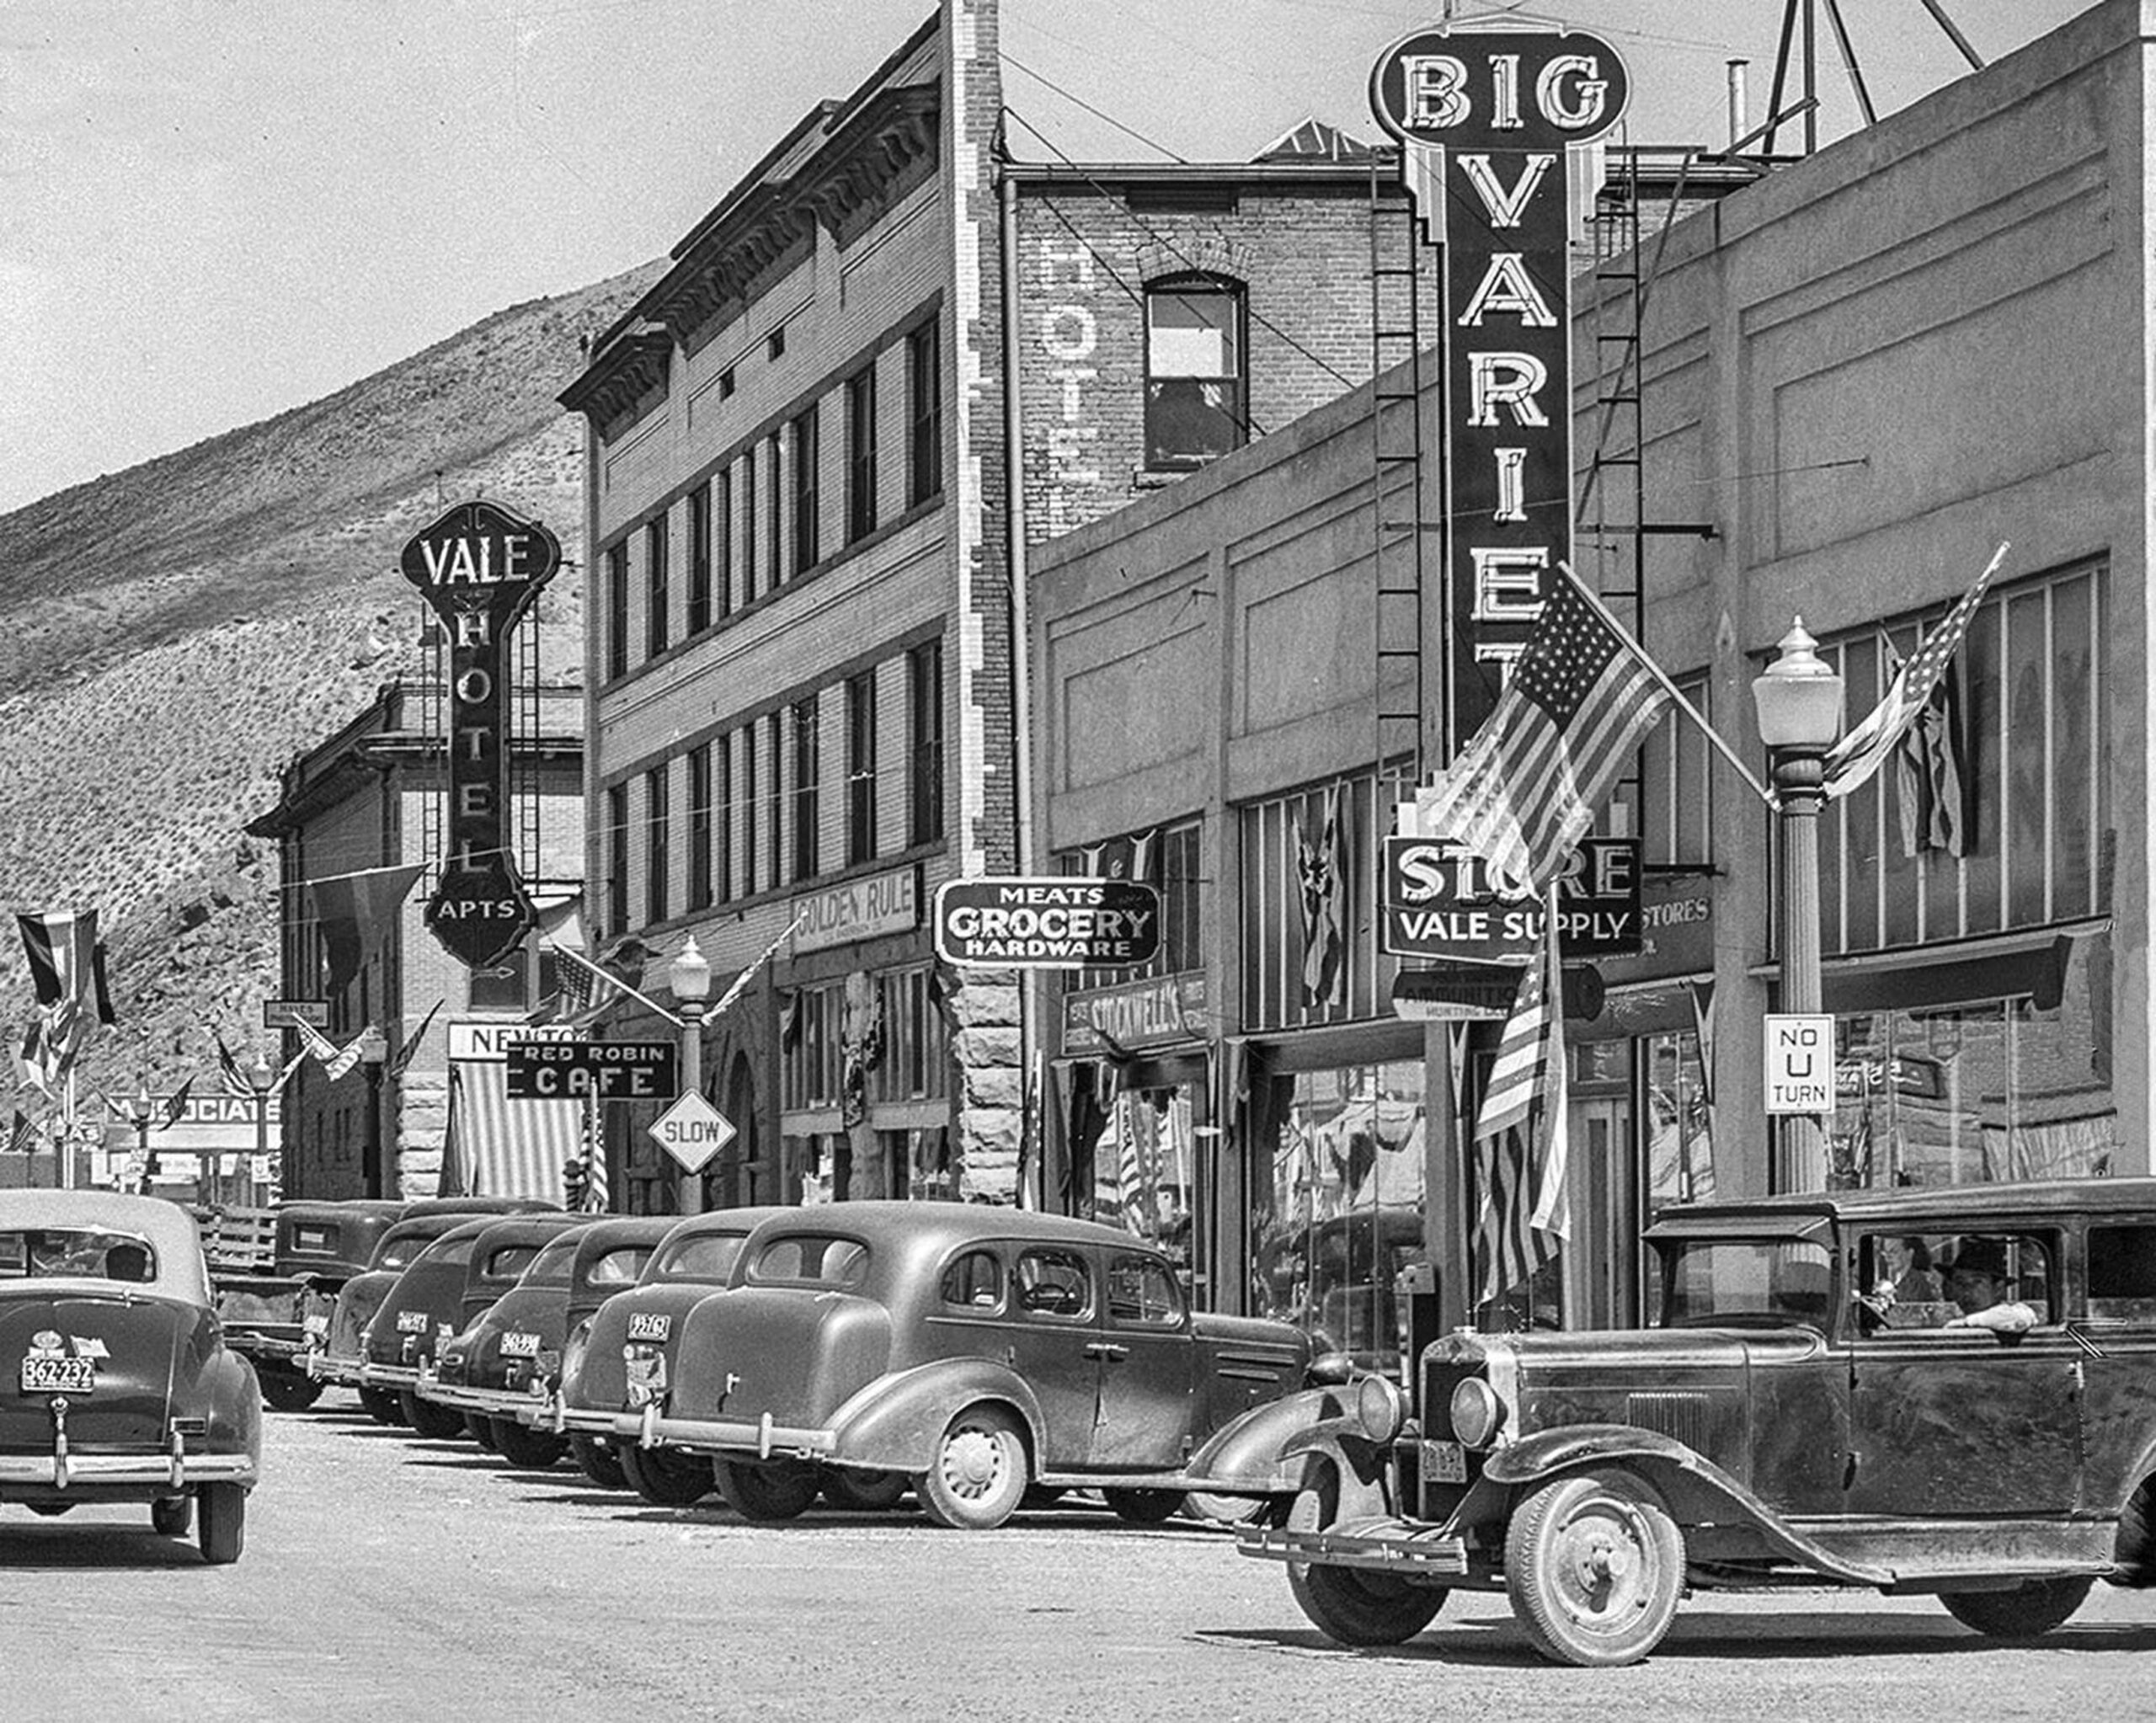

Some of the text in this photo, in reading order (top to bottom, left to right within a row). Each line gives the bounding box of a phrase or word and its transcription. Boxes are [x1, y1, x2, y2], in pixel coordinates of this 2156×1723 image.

[1400, 54, 1609, 129] BIG
[1457, 153, 1558, 694] VARIET
[420, 535, 531, 586] VALE
[456, 611, 494, 874] HOTEL
[798, 888, 859, 937] GOLDEN
[867, 872, 912, 922] RULE
[1000, 887, 1105, 905] MEATS
[437, 899, 516, 920] APTS
[947, 906, 1152, 941] GROCERY
[1399, 912, 1490, 941] VALE
[965, 939, 1132, 957] HARDWARE
[1780, 1028, 1818, 1046] NO
[524, 1046, 664, 1062] RED ROBIN
[1786, 1053, 1812, 1077] U
[535, 1067, 654, 1096] CAFE
[1773, 1085, 1826, 1102] TURN
[664, 1120, 720, 1143] SLOW
